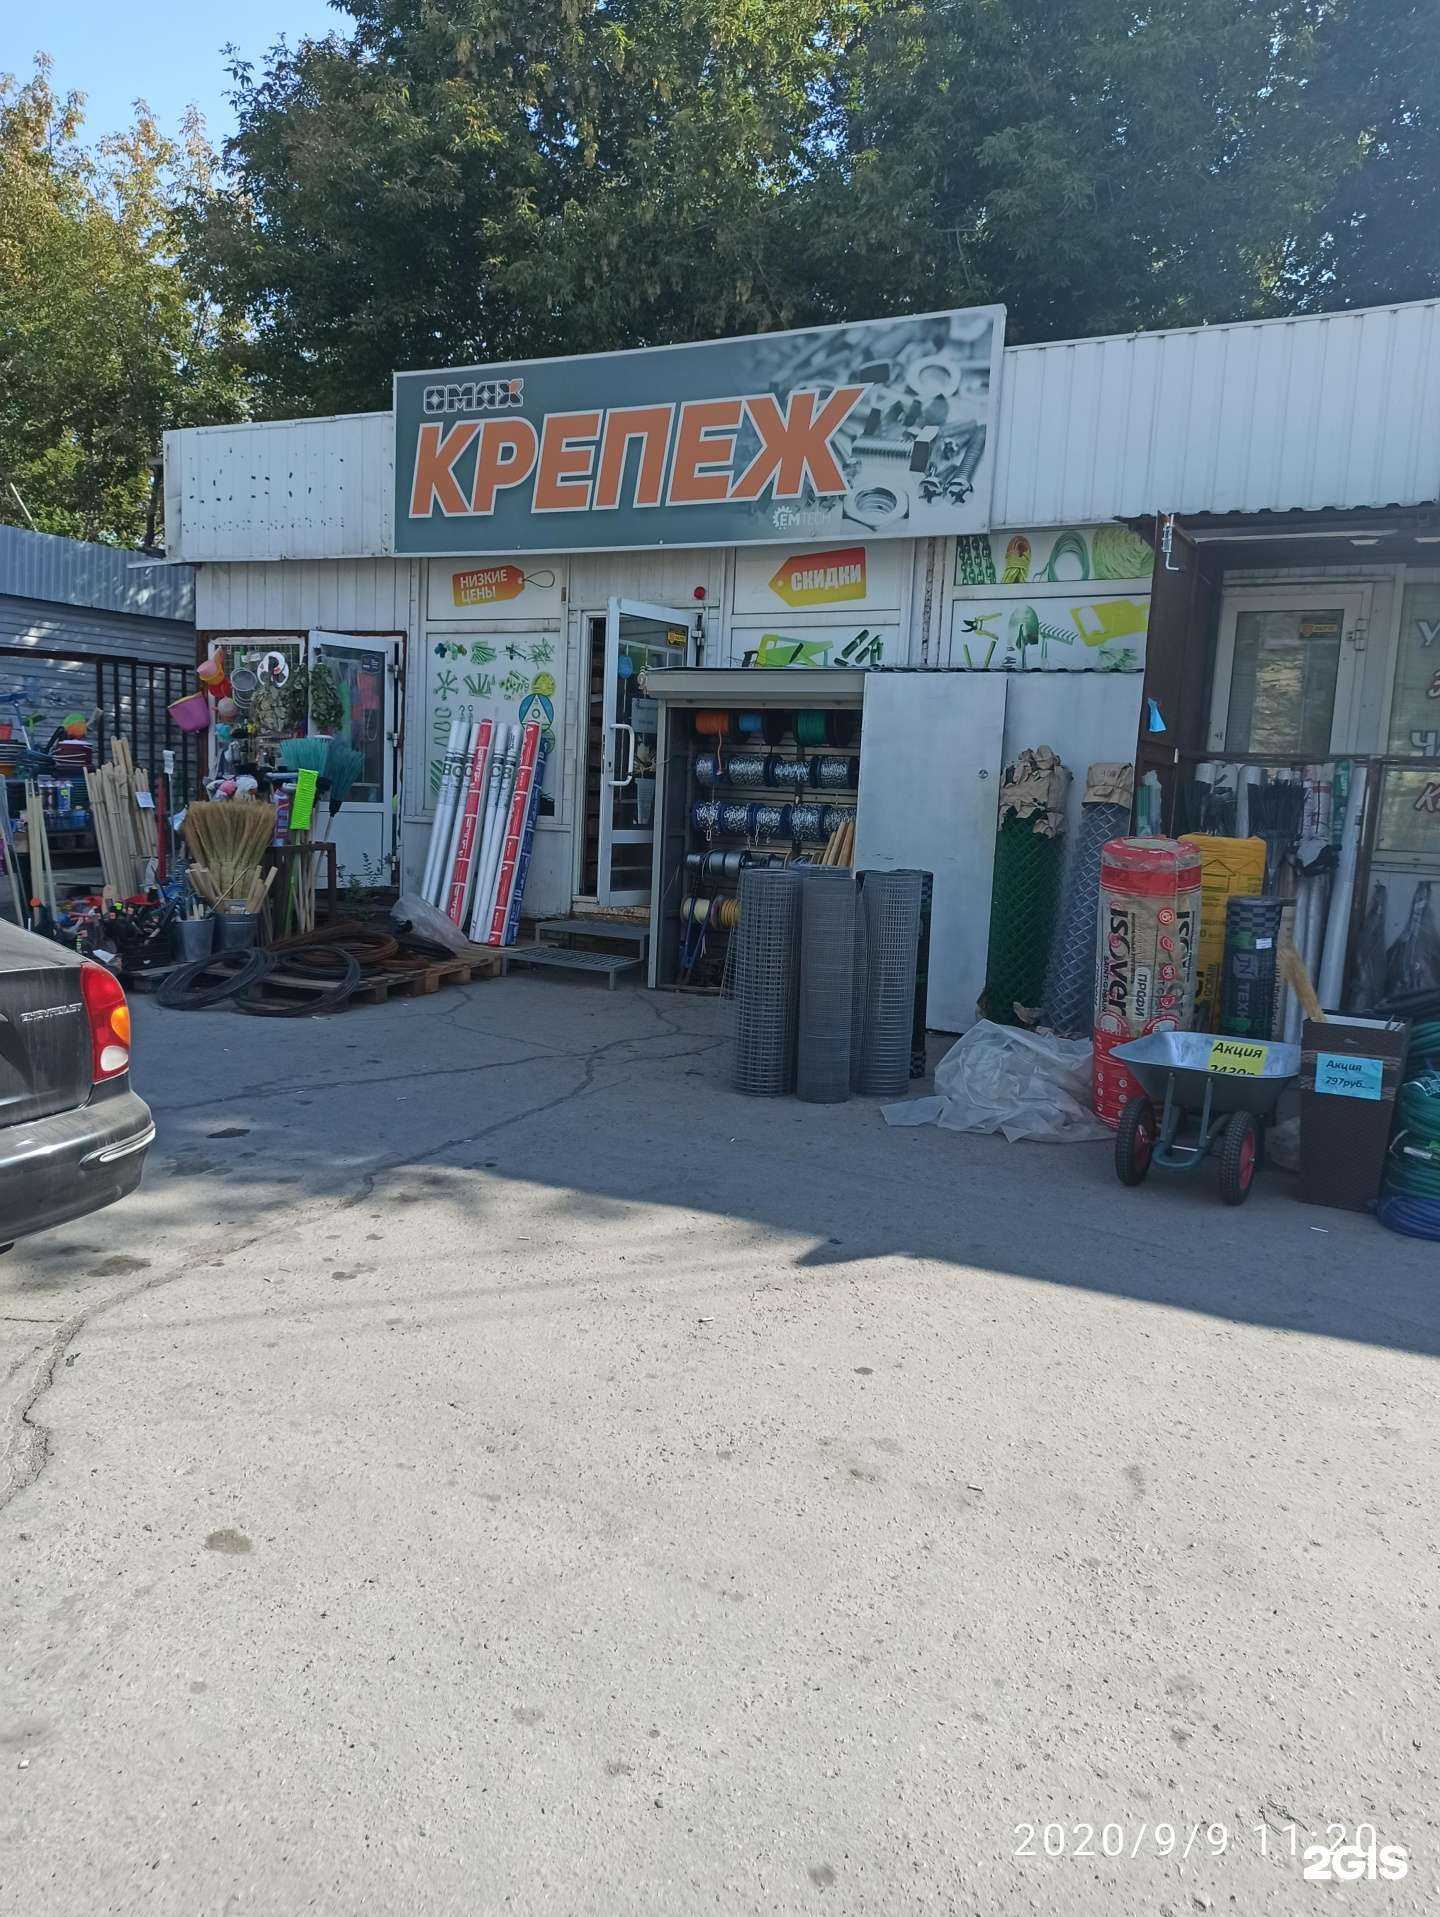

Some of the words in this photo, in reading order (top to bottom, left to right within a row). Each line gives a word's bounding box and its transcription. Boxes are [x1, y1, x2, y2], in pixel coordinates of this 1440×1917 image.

[424, 378, 524, 415] OMAX
[408, 382, 873, 519] КРЕПЕЖ
[460, 569, 508, 589] НИЗКИЕ
[791, 563, 861, 592] СКИДКИ
[461, 585, 497, 605] ЦЕНЫ
[1212, 1042, 1263, 1059] Акция
[1326, 1059, 1362, 1073] Акция
